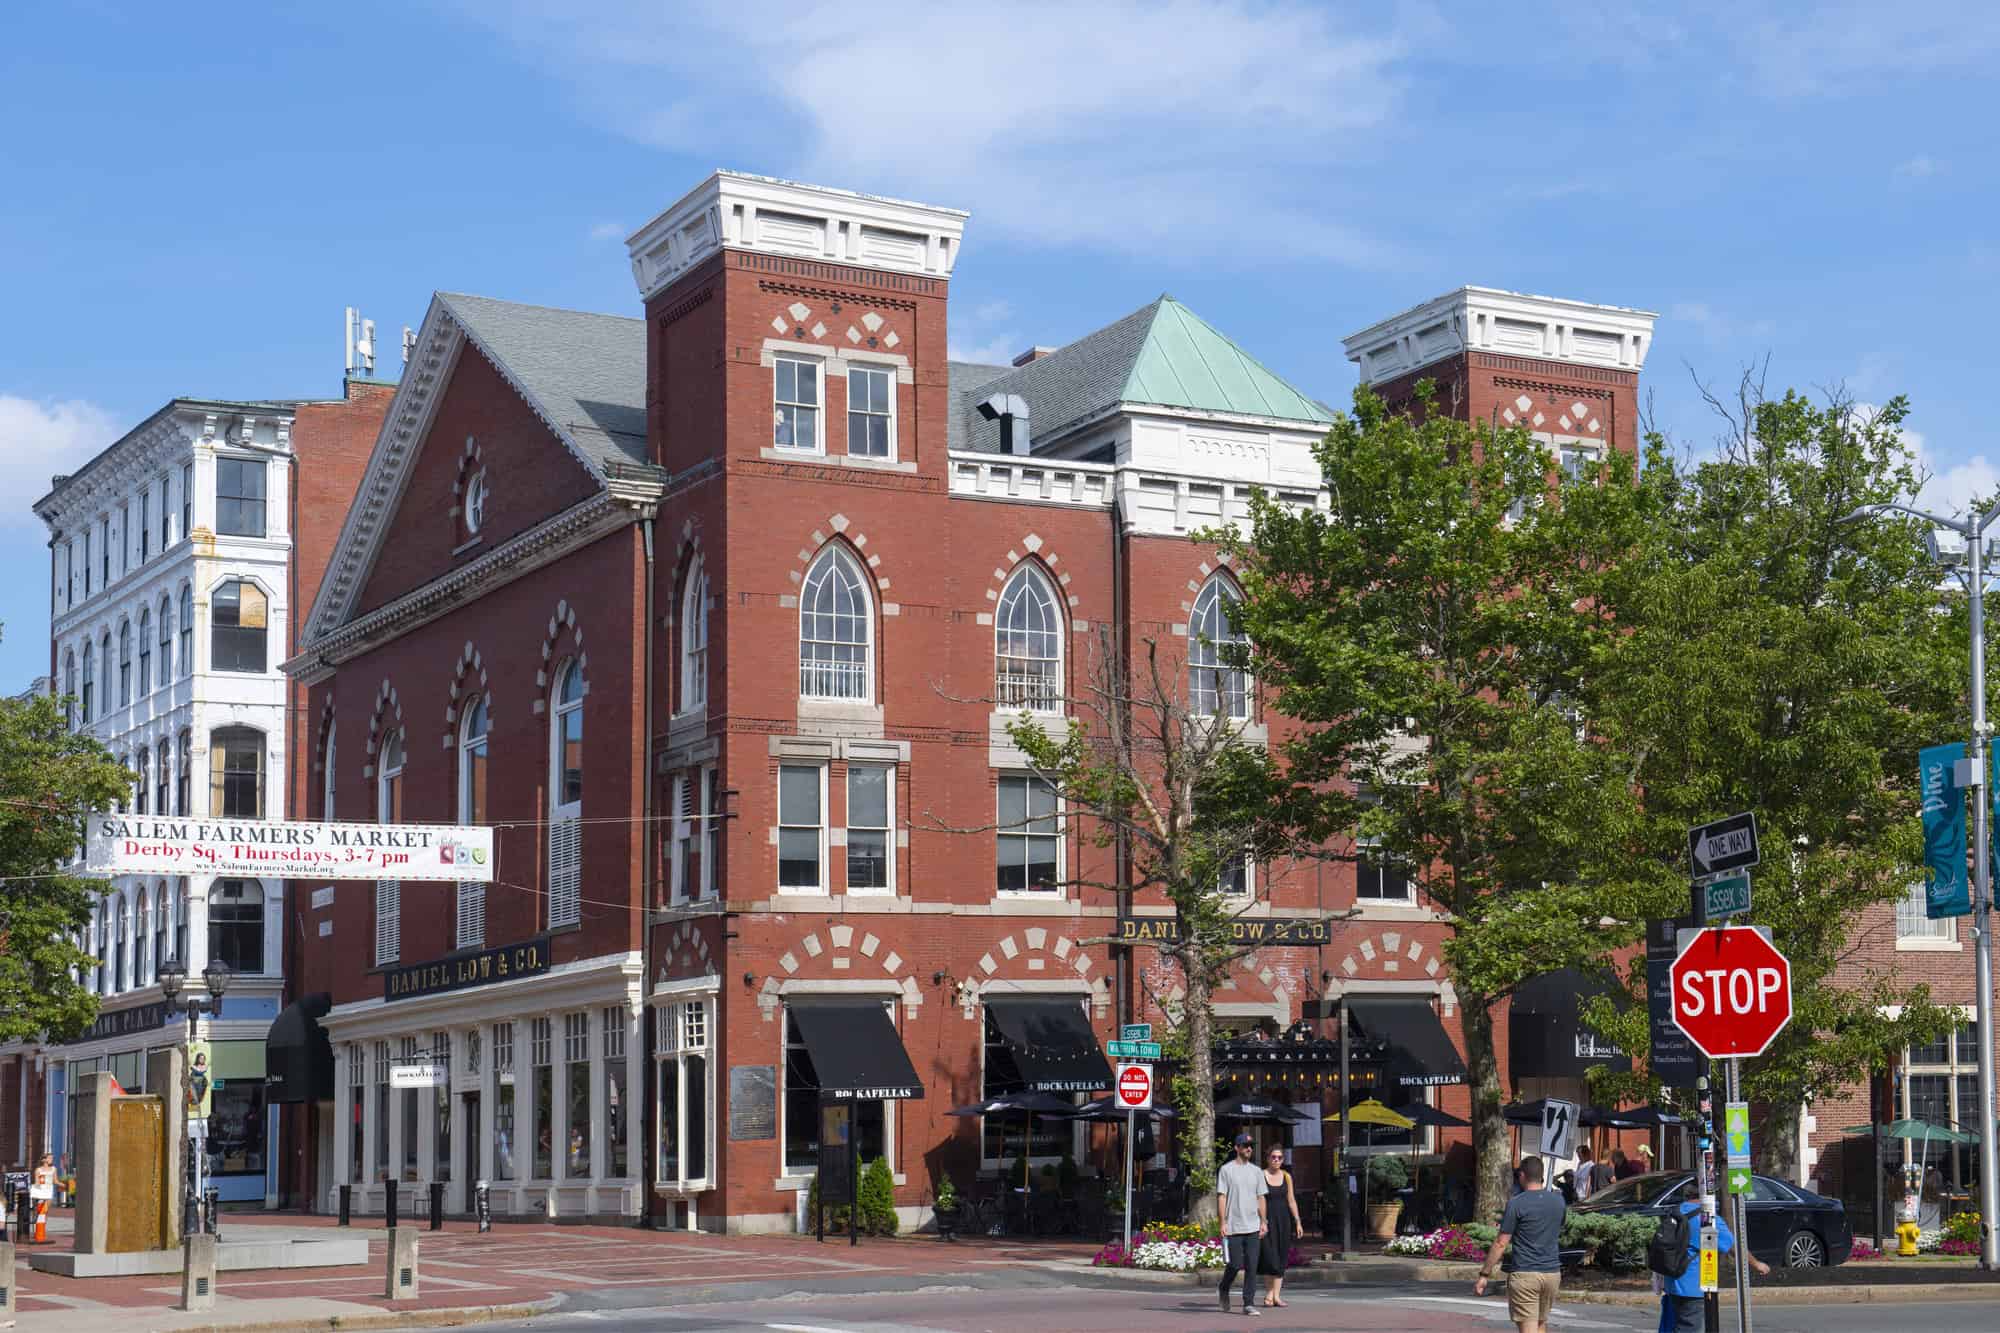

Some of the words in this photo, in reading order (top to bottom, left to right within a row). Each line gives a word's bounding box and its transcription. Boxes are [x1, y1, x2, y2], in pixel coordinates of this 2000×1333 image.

[102, 820, 187, 841] SALEM
[198, 825, 321, 846] FARMERS'
[330, 829, 433, 848] MARKET
[1709, 837, 1728, 858] ONE
[1727, 831, 1748, 852] WAY
[125, 840, 184, 862] Derby
[192, 843, 222, 864] Sq.
[230, 844, 339, 867] Thursdays,
[345, 848, 374, 863] 3-7
[381, 851, 409, 868] pm
[196, 862, 335, 875] www.SalemFarmersMarket.org
[1707, 886, 1735, 913] Essex
[1123, 920, 1178, 939] DANI
[1232, 922, 1264, 940] OW
[1275, 923, 1288, 939] &
[1298, 923, 1329, 940] CO.
[391, 964, 450, 995] DANIEL
[457, 956, 492, 983] LOW
[497, 952, 508, 976] &
[514, 947, 542, 971] CO.
[1681, 967, 1781, 1017] STOP
[1109, 1043, 1153, 1054] WASHINGTON
[1580, 1044, 1611, 1055] COLONIAL
[1227, 1053, 1371, 1061] ROCKAFELAS
[1037, 1081, 1106, 1092] ROCKAFELLAS
[1400, 1075, 1461, 1086] ROCKAFELLAS
[835, 1088, 912, 1099] ROKAFELLAS
